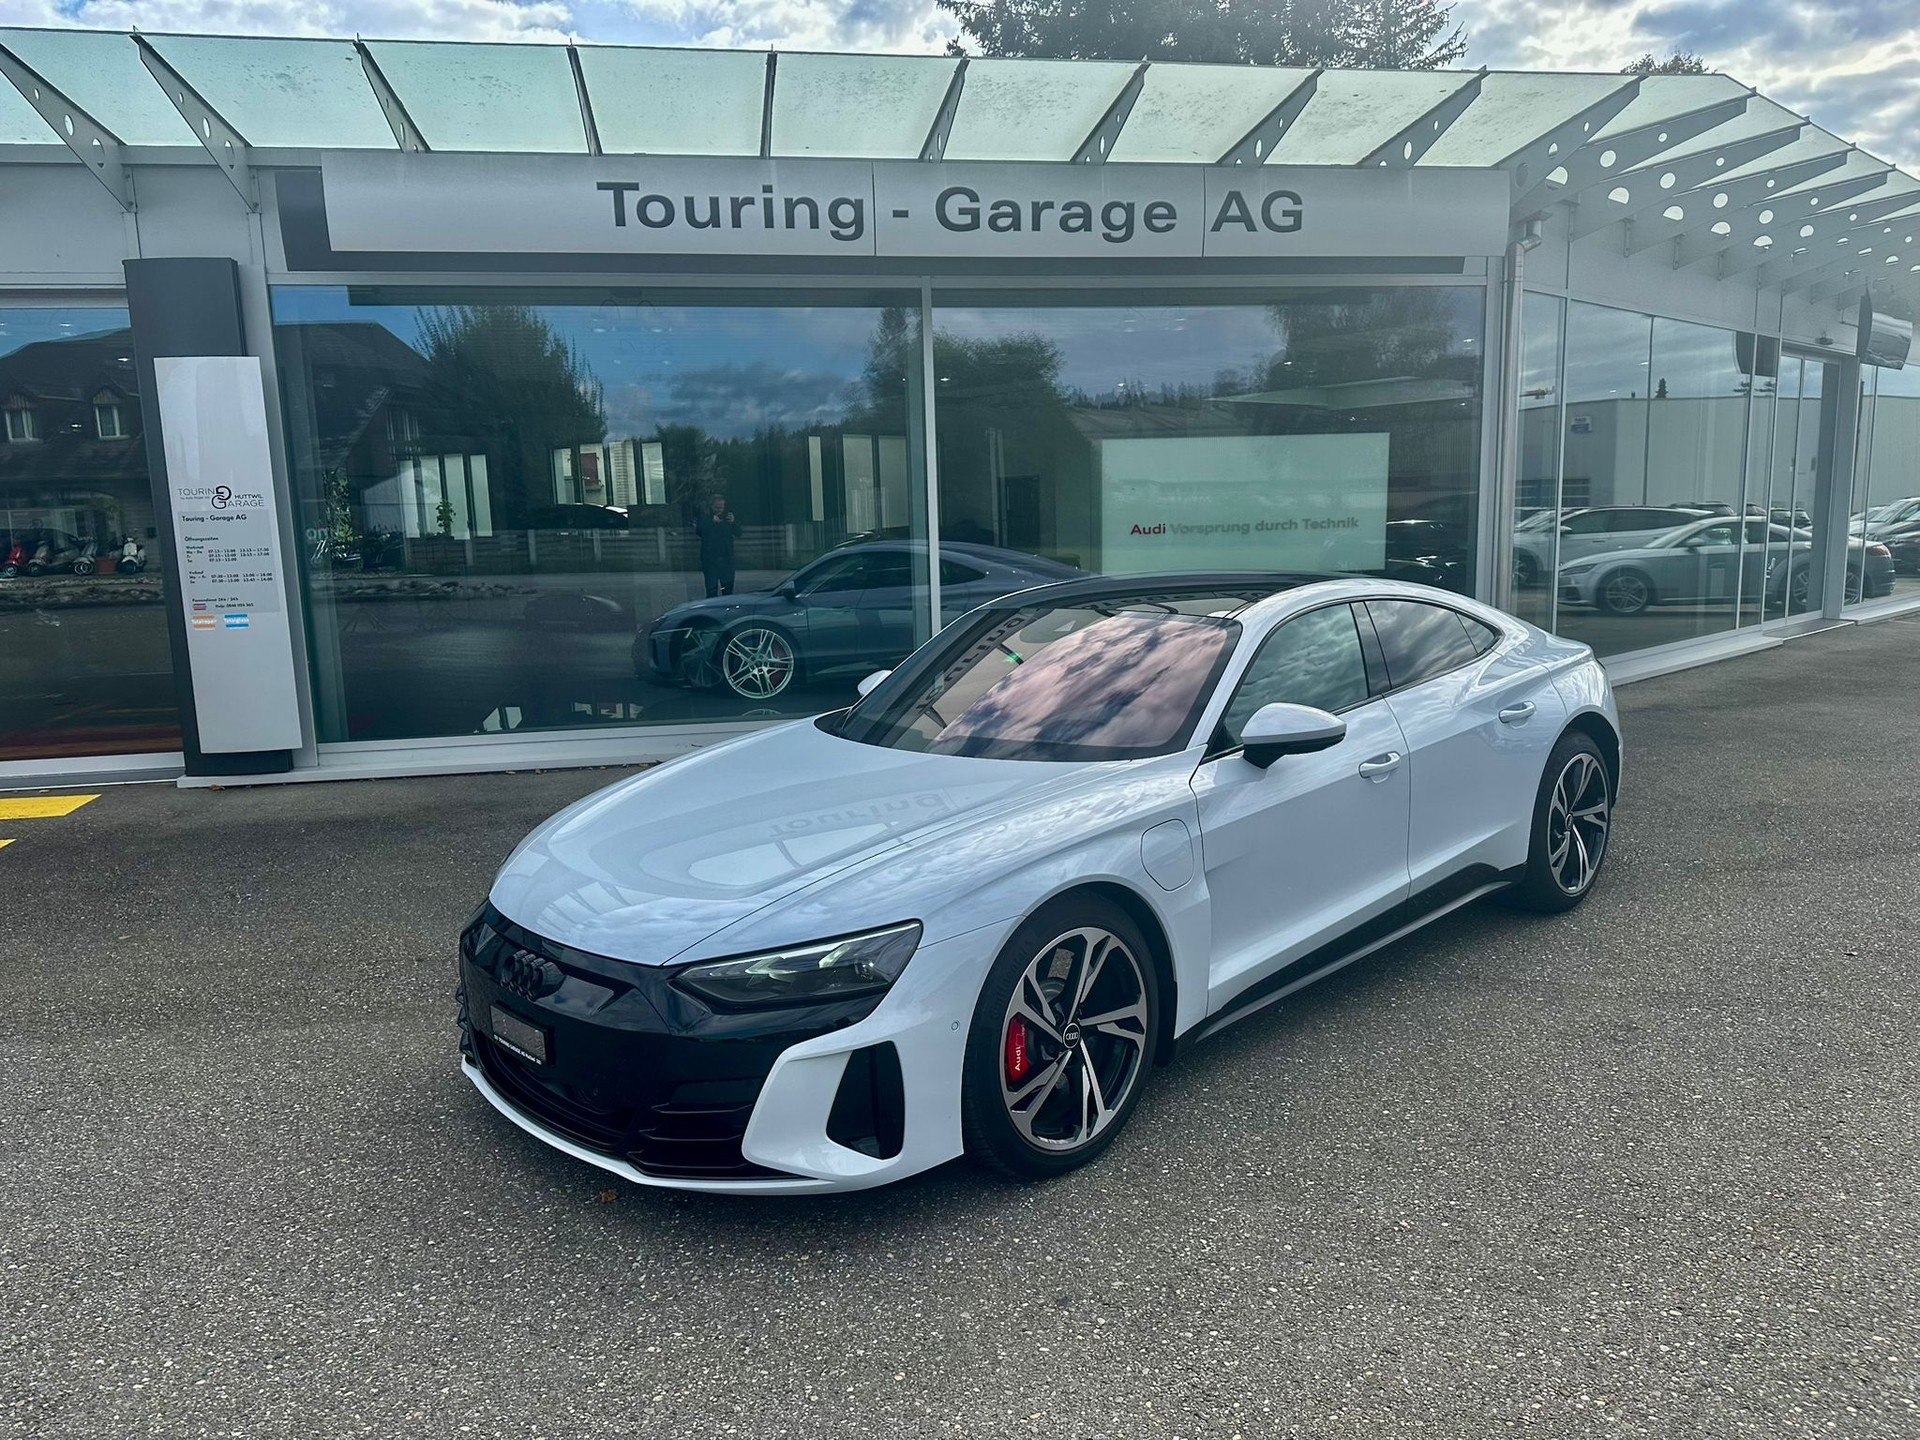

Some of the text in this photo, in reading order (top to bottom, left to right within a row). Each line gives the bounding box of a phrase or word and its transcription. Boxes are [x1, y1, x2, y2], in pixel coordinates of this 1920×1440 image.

[596, 181, 1304, 244] Touring - Garage AG
[182, 515, 205, 523] Touring
[210, 514, 234, 522] Garage
[236, 513, 247, 521] AG
[1130, 517, 1360, 535] Audi Vorsprung durch Technik
[1014, 1045, 1022, 1071] Audi
